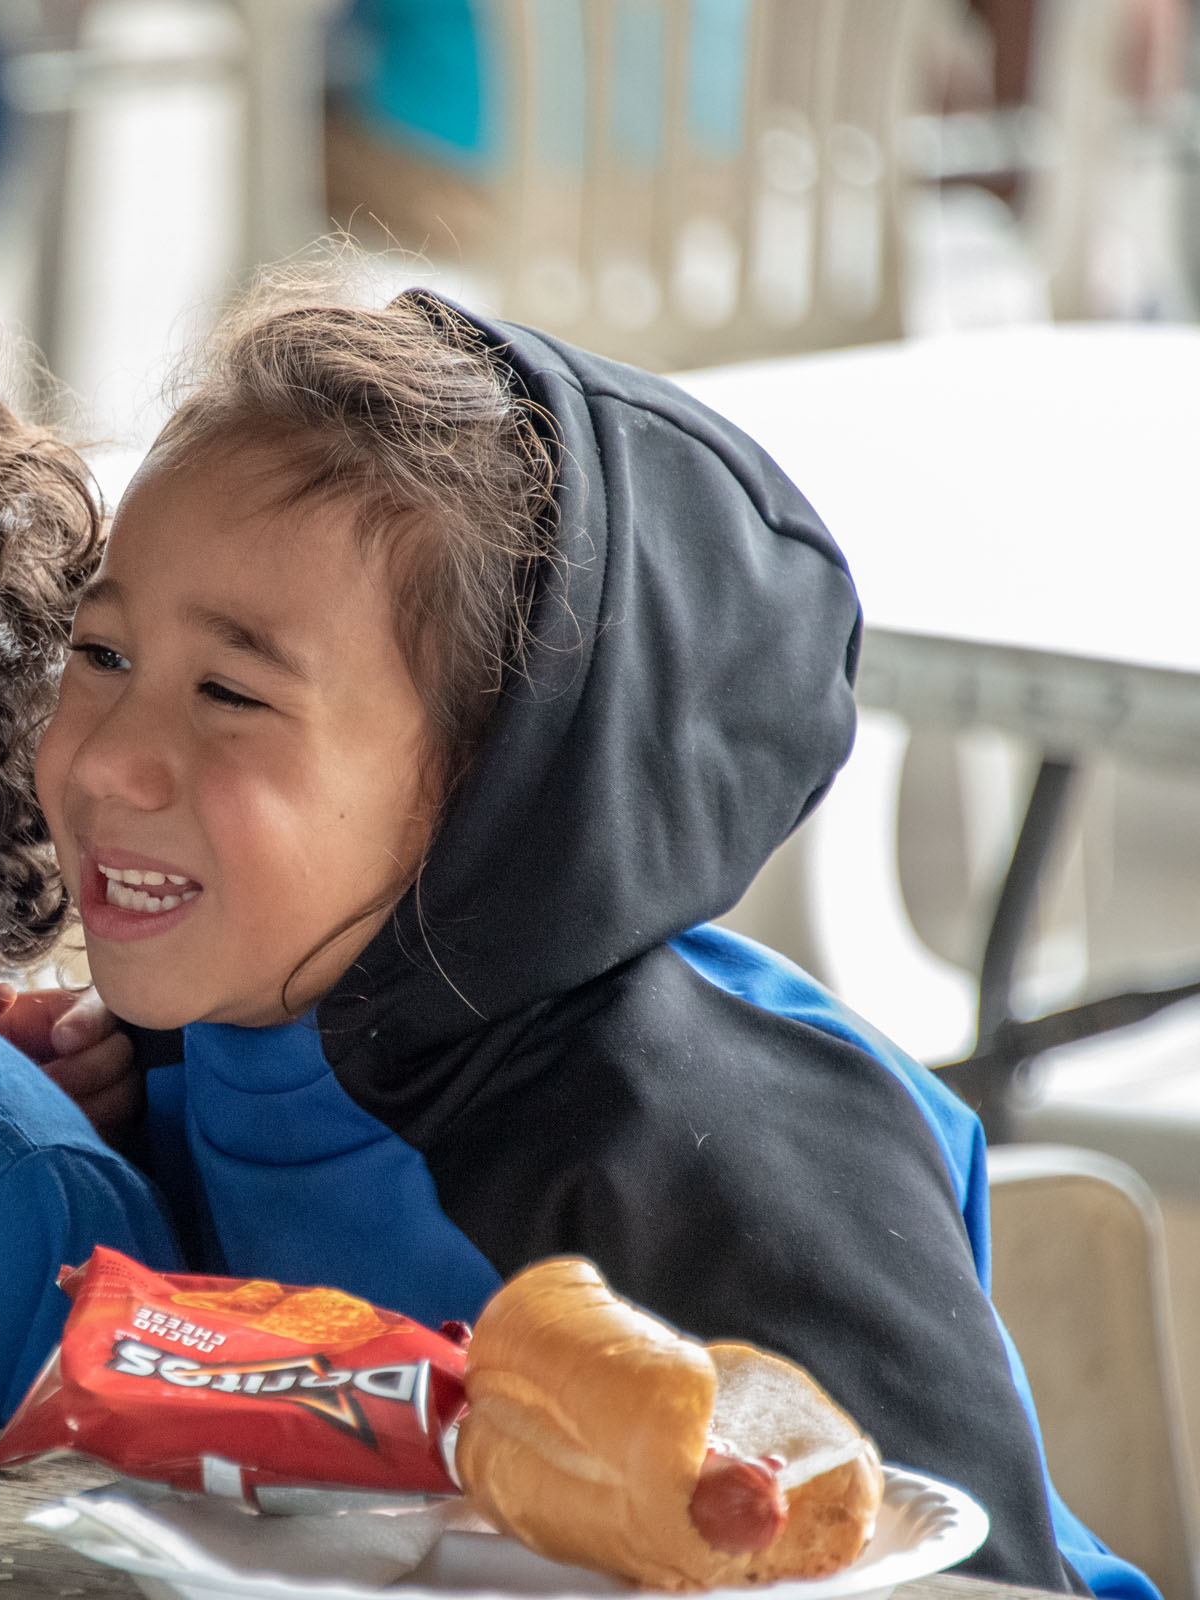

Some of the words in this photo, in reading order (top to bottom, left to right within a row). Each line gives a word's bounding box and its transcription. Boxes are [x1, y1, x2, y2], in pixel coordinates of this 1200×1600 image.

[132, 1317, 215, 1353] NACHO
[136, 1307, 227, 1346] CHEESE
[116, 1342, 420, 1402] Doritos
